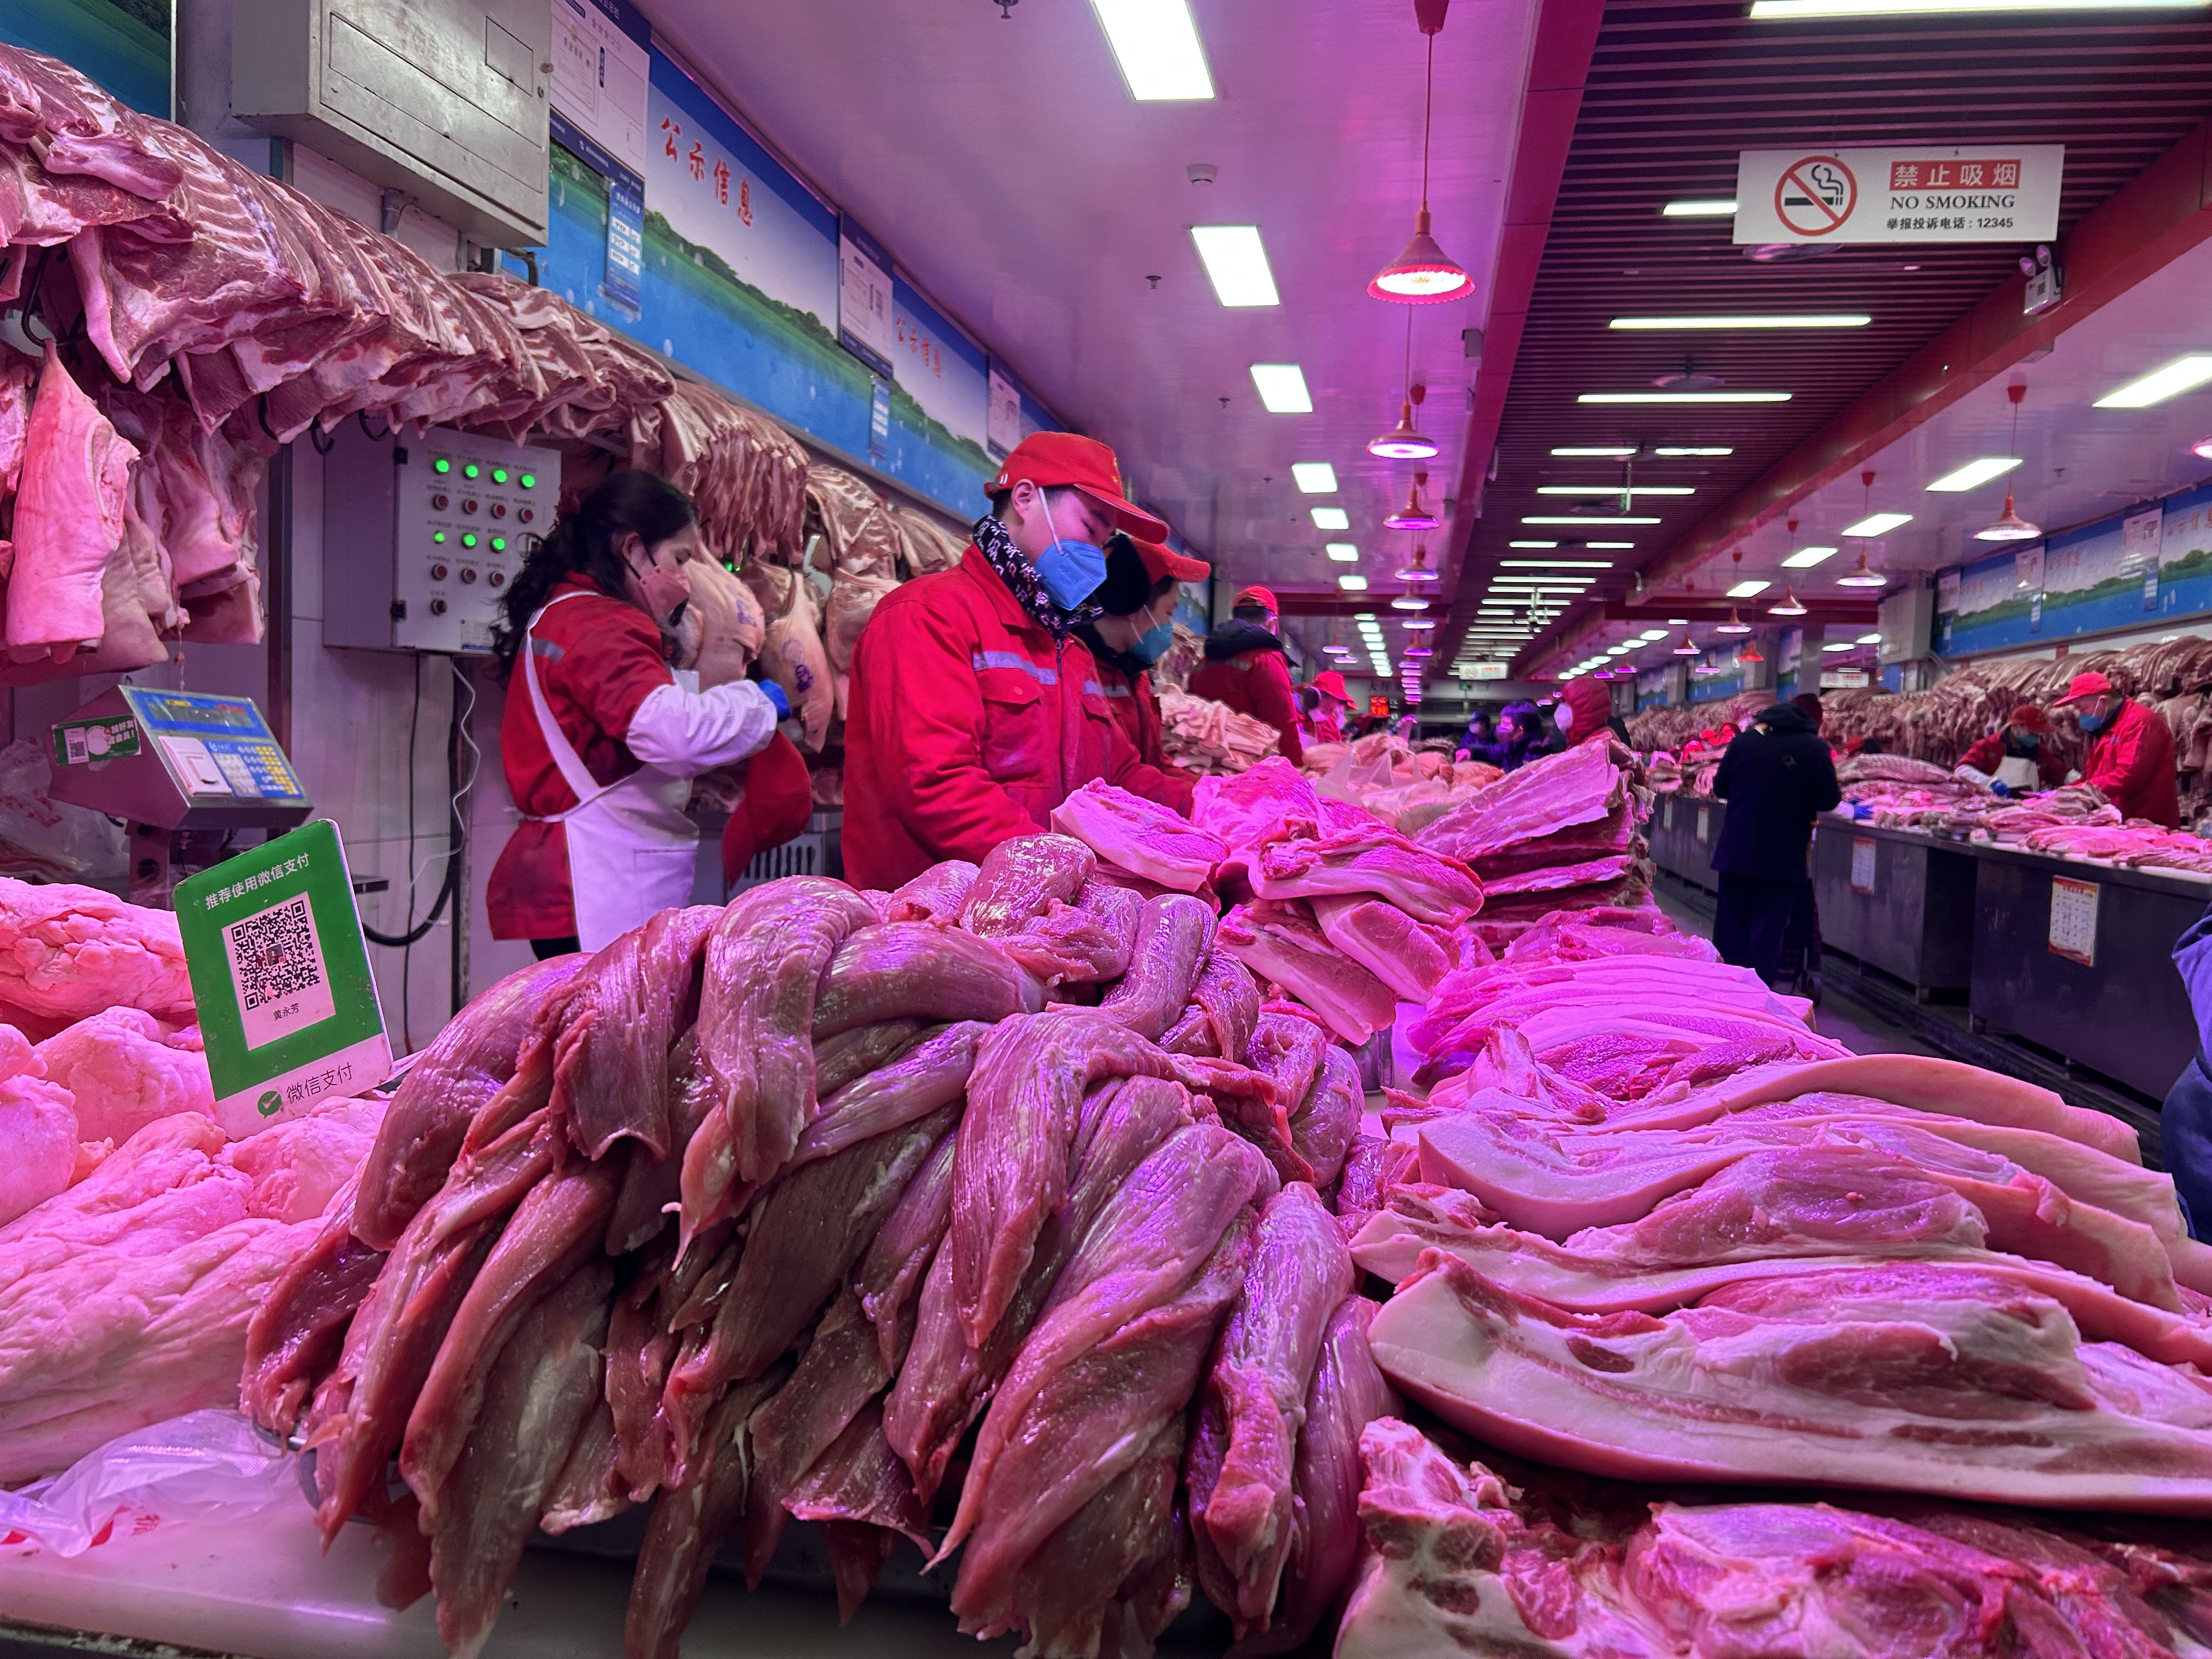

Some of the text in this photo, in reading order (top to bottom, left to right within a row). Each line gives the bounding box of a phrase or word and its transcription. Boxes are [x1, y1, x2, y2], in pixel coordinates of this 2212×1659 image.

[661, 116, 753, 227] 公示信息
[1894, 163, 2017, 187] 禁止吸烟
[1891, 195, 2015, 209] NO SMOKING
[205, 852, 309, 910] 推荐使用微信支付
[274, 1003, 299, 1021] 黄永芳
[286, 1062, 352, 1104] 微信支付
